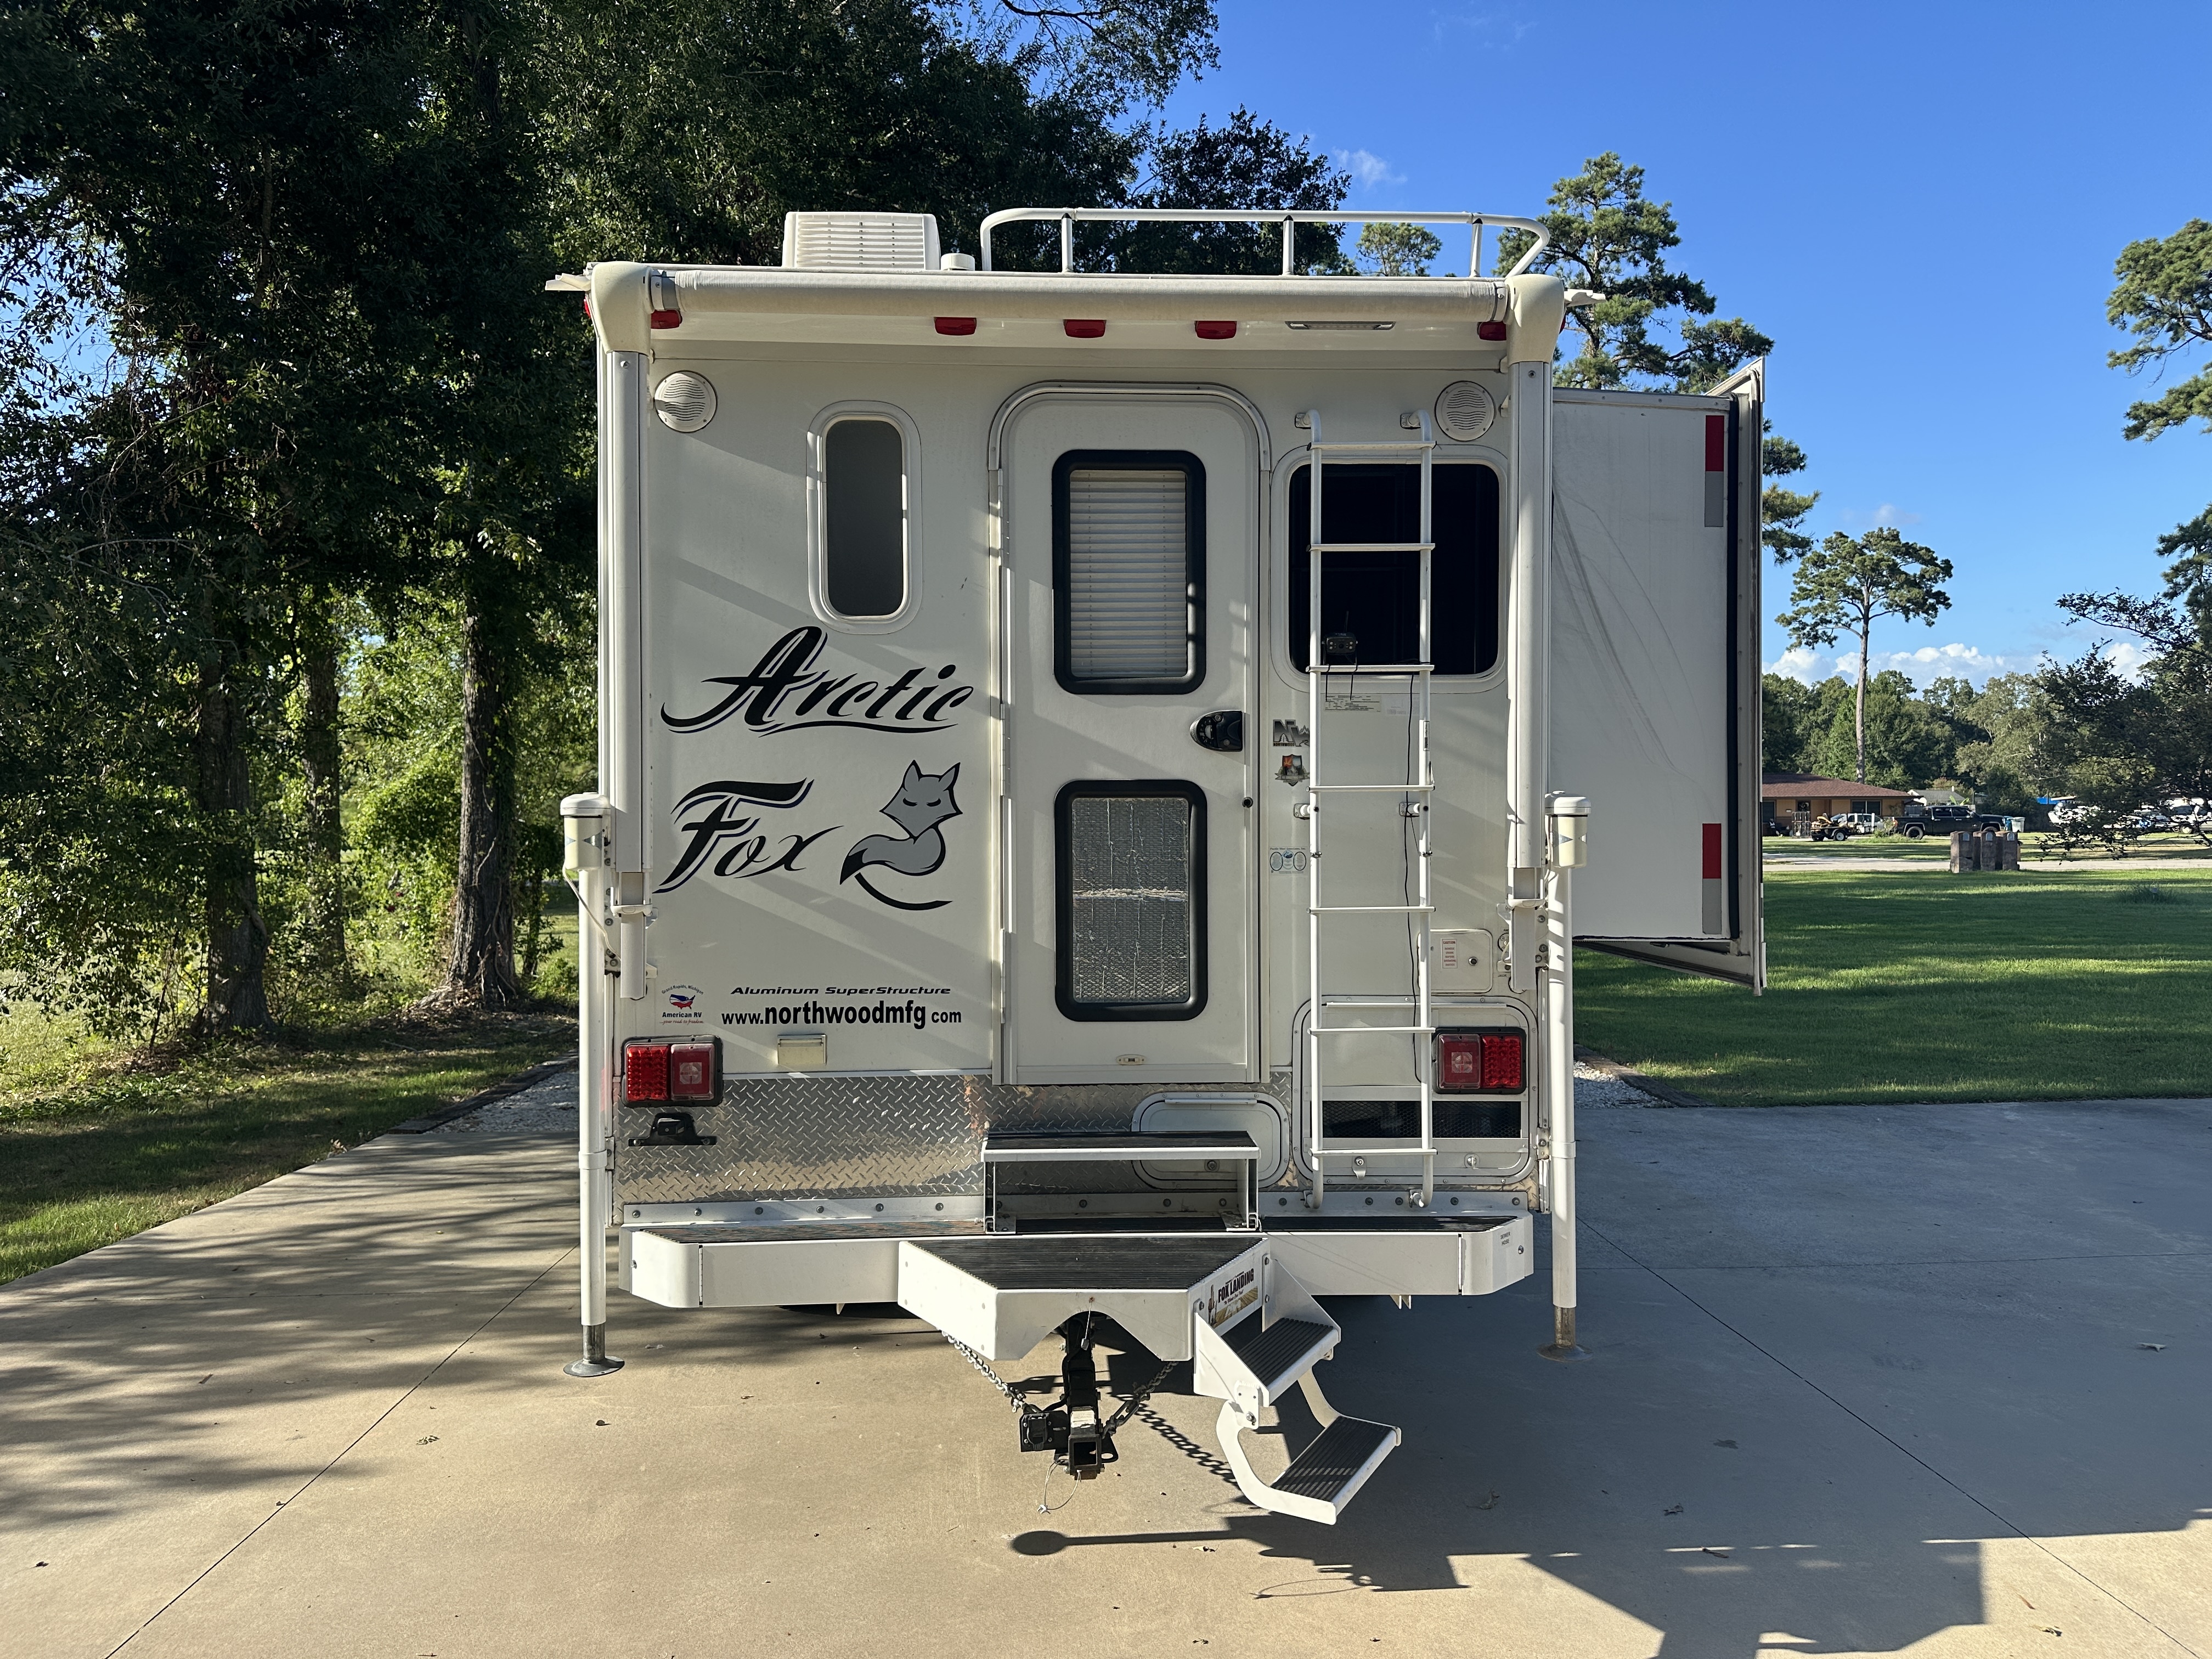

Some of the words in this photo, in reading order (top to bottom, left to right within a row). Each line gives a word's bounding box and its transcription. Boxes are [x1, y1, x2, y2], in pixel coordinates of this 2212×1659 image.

[661, 625, 974, 737] Arctic
[653, 777, 844, 894] Fox
[662, 986, 673, 994] Grand
[688, 985, 703, 995] Michigan
[825, 987, 951, 996] SuperStructure
[1218, 1284, 1229, 1303] FOX
[1230, 1268, 1254, 1295] LANDING
